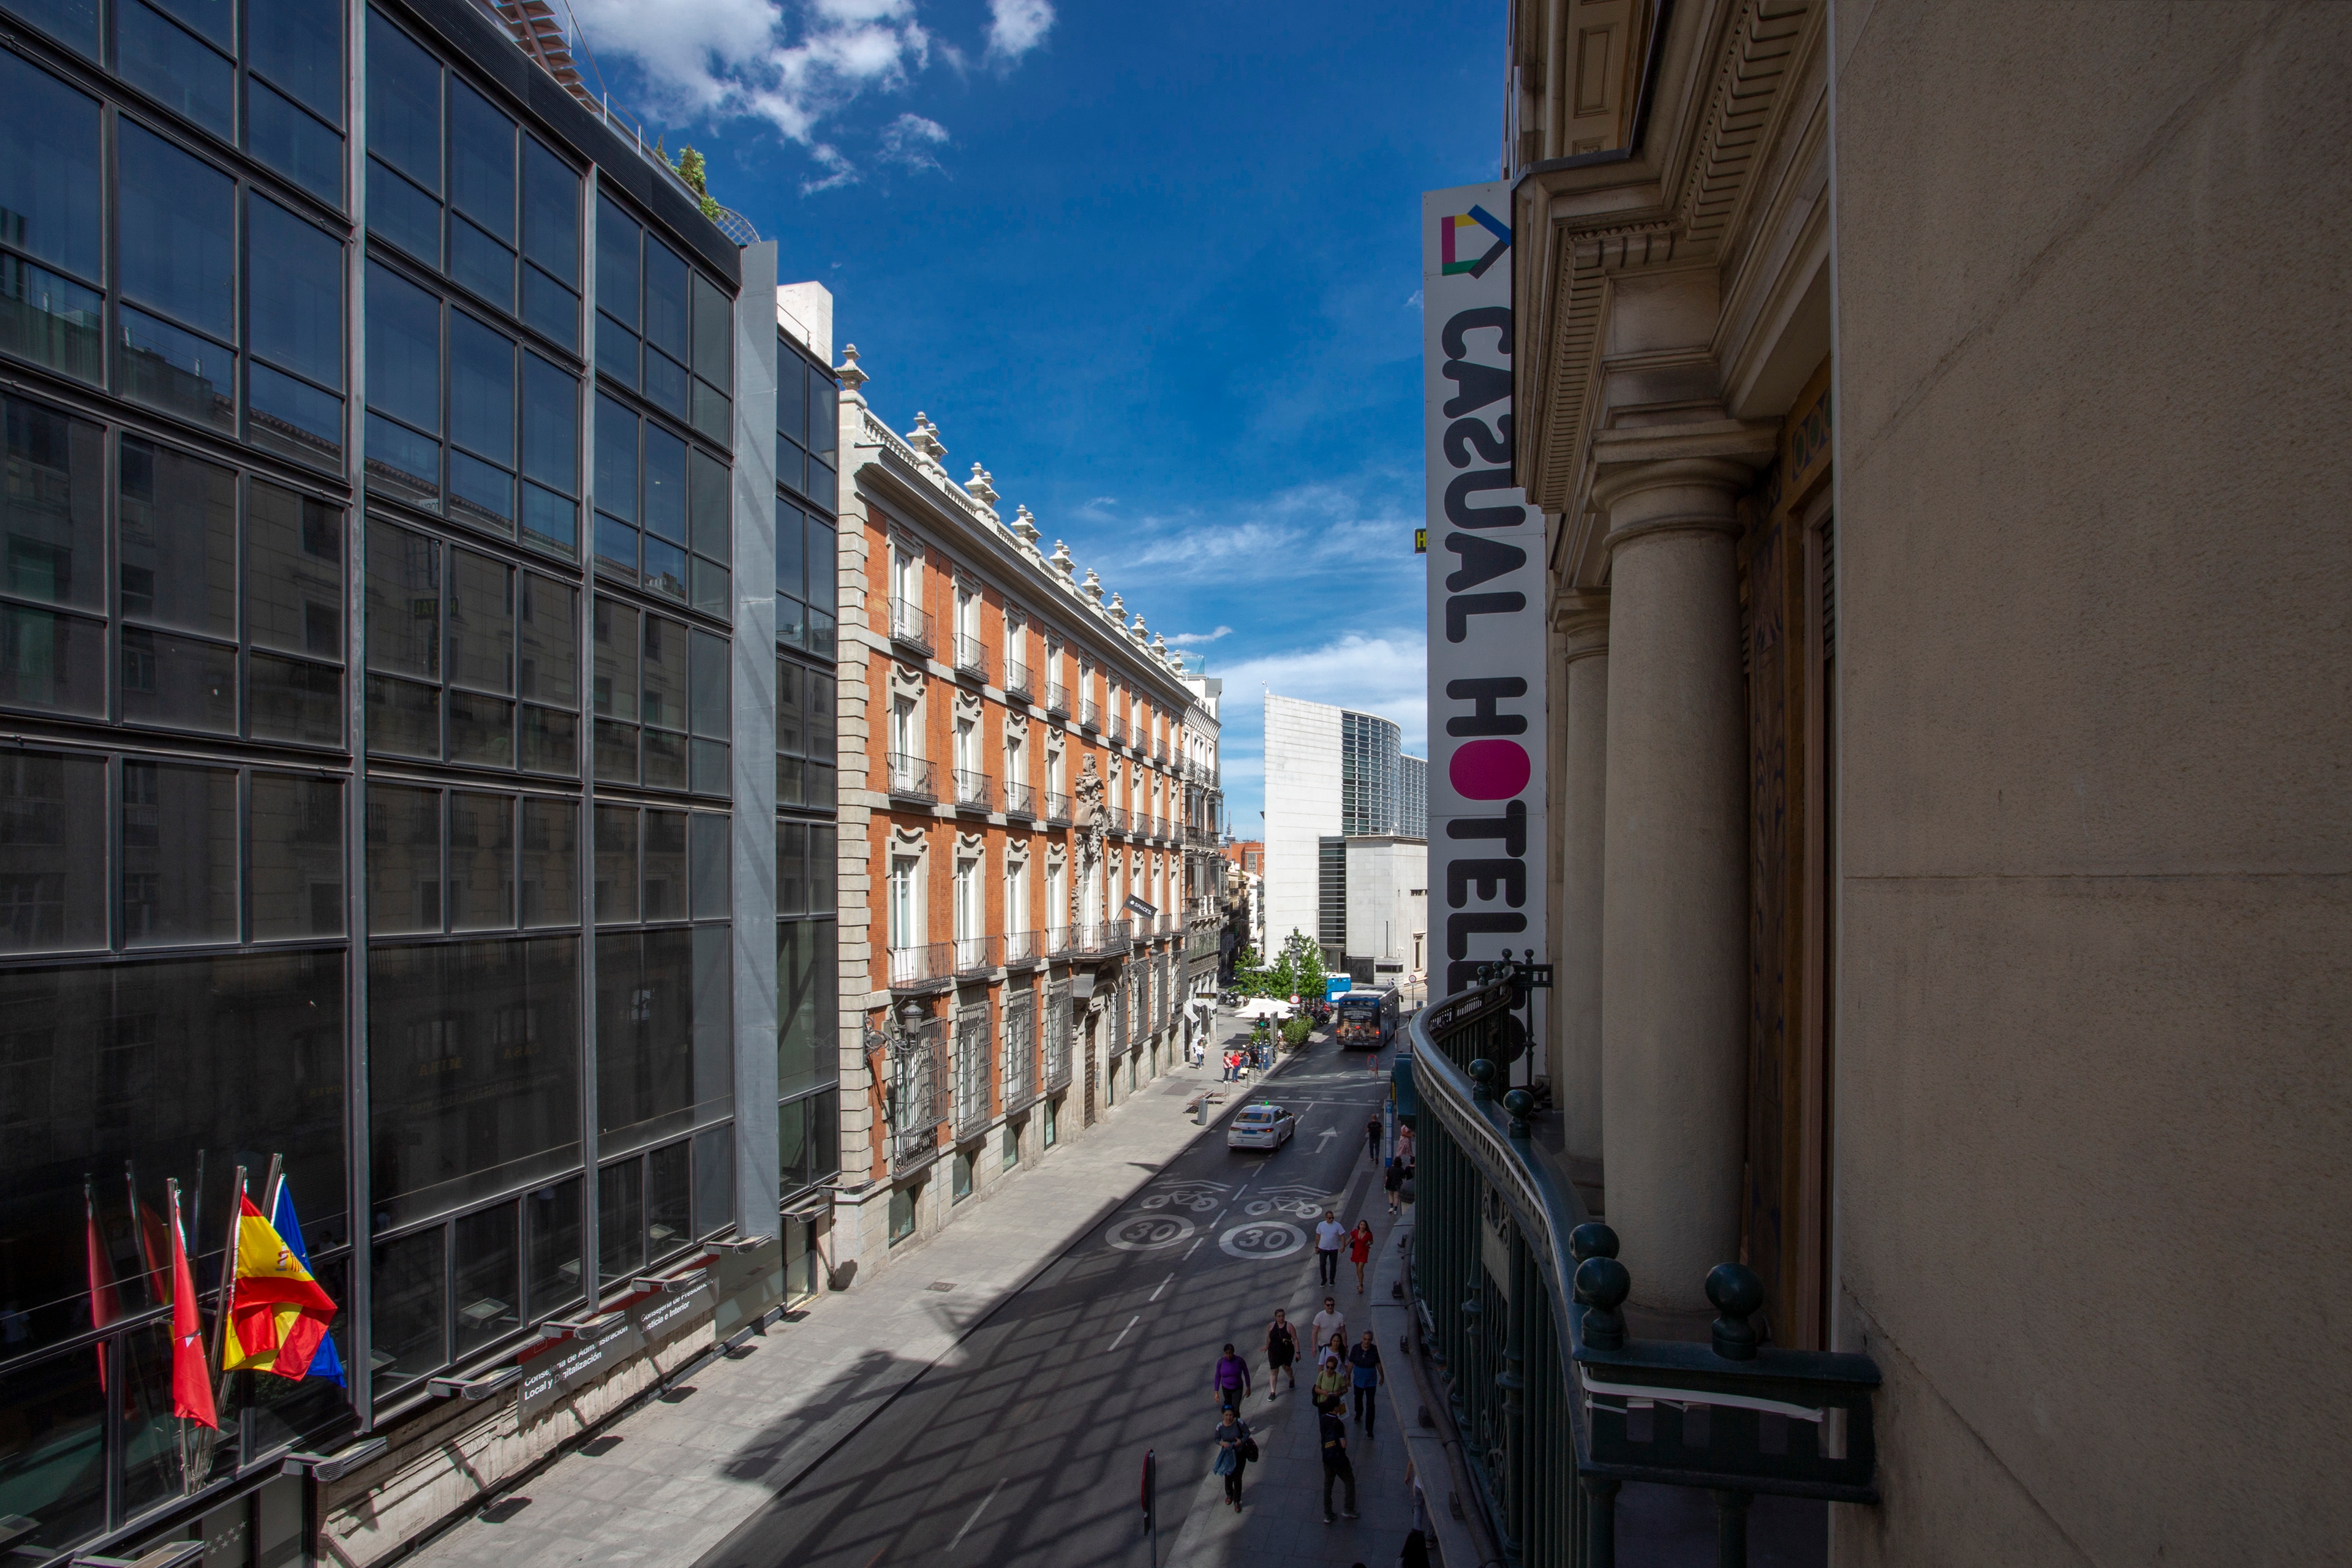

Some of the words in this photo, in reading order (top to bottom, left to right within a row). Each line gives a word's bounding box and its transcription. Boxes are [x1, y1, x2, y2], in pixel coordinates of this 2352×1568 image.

[1441, 306, 1526, 643] CASUAL
[1126, 1221, 1177, 1242] 30
[1238, 1229, 1288, 1250] 30
[641, 1298, 673, 1322] Consejería
[673, 1295, 680, 1305] de
[641, 1315, 664, 1335] Justicia
[669, 1300, 690, 1318] Interior
[524, 1359, 567, 1388] Consejería
[567, 1352, 578, 1364] de
[578, 1325, 628, 1359] Administración
[524, 1381, 547, 1401] Local
[547, 1378, 554, 1390] y
[554, 1351, 603, 1384] Digitalización
